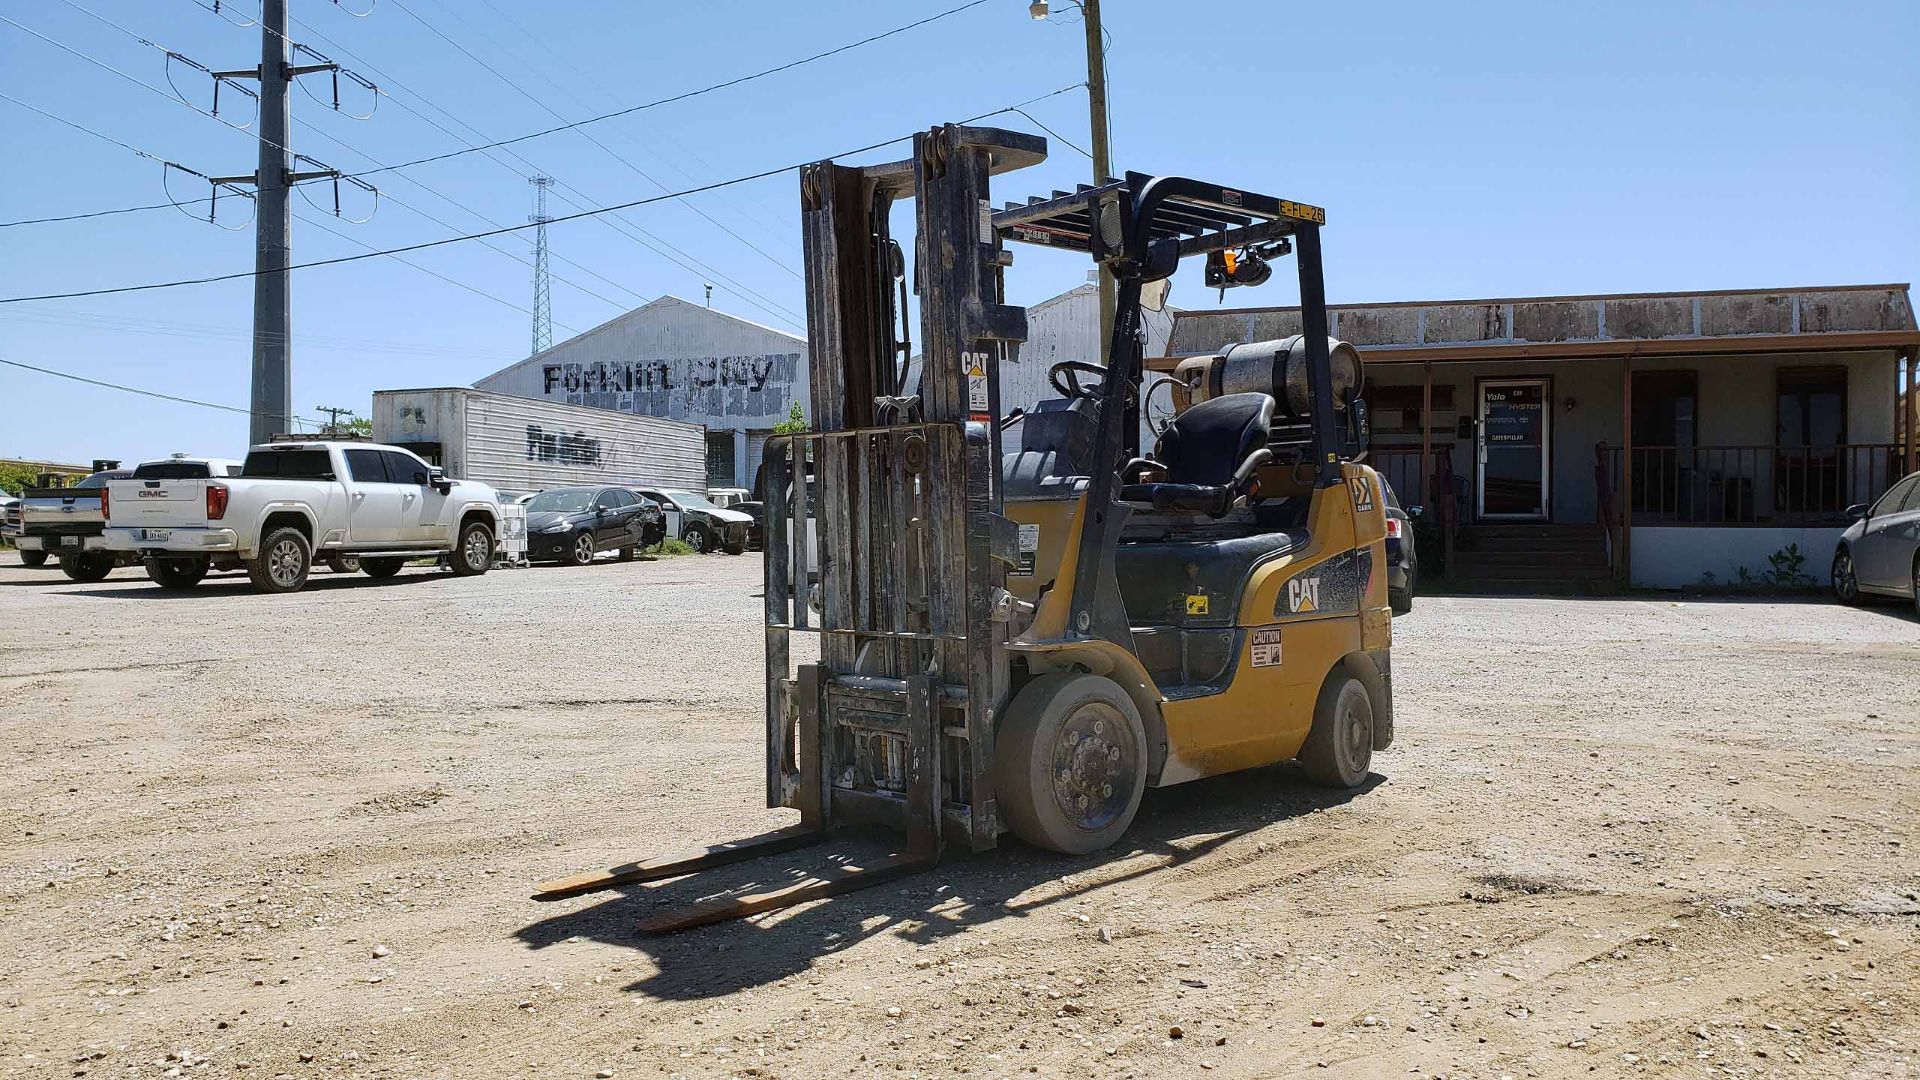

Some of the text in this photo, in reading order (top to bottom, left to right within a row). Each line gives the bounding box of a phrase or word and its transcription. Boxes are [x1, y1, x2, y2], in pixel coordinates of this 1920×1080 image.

[961, 351, 988, 376] CAT
[543, 355, 774, 394] Forklift City
[1486, 393, 1506, 401] Yale
[138, 490, 169, 498] GMC
[1288, 577, 1320, 613] CAT
[1252, 630, 1281, 645] CAUTION
